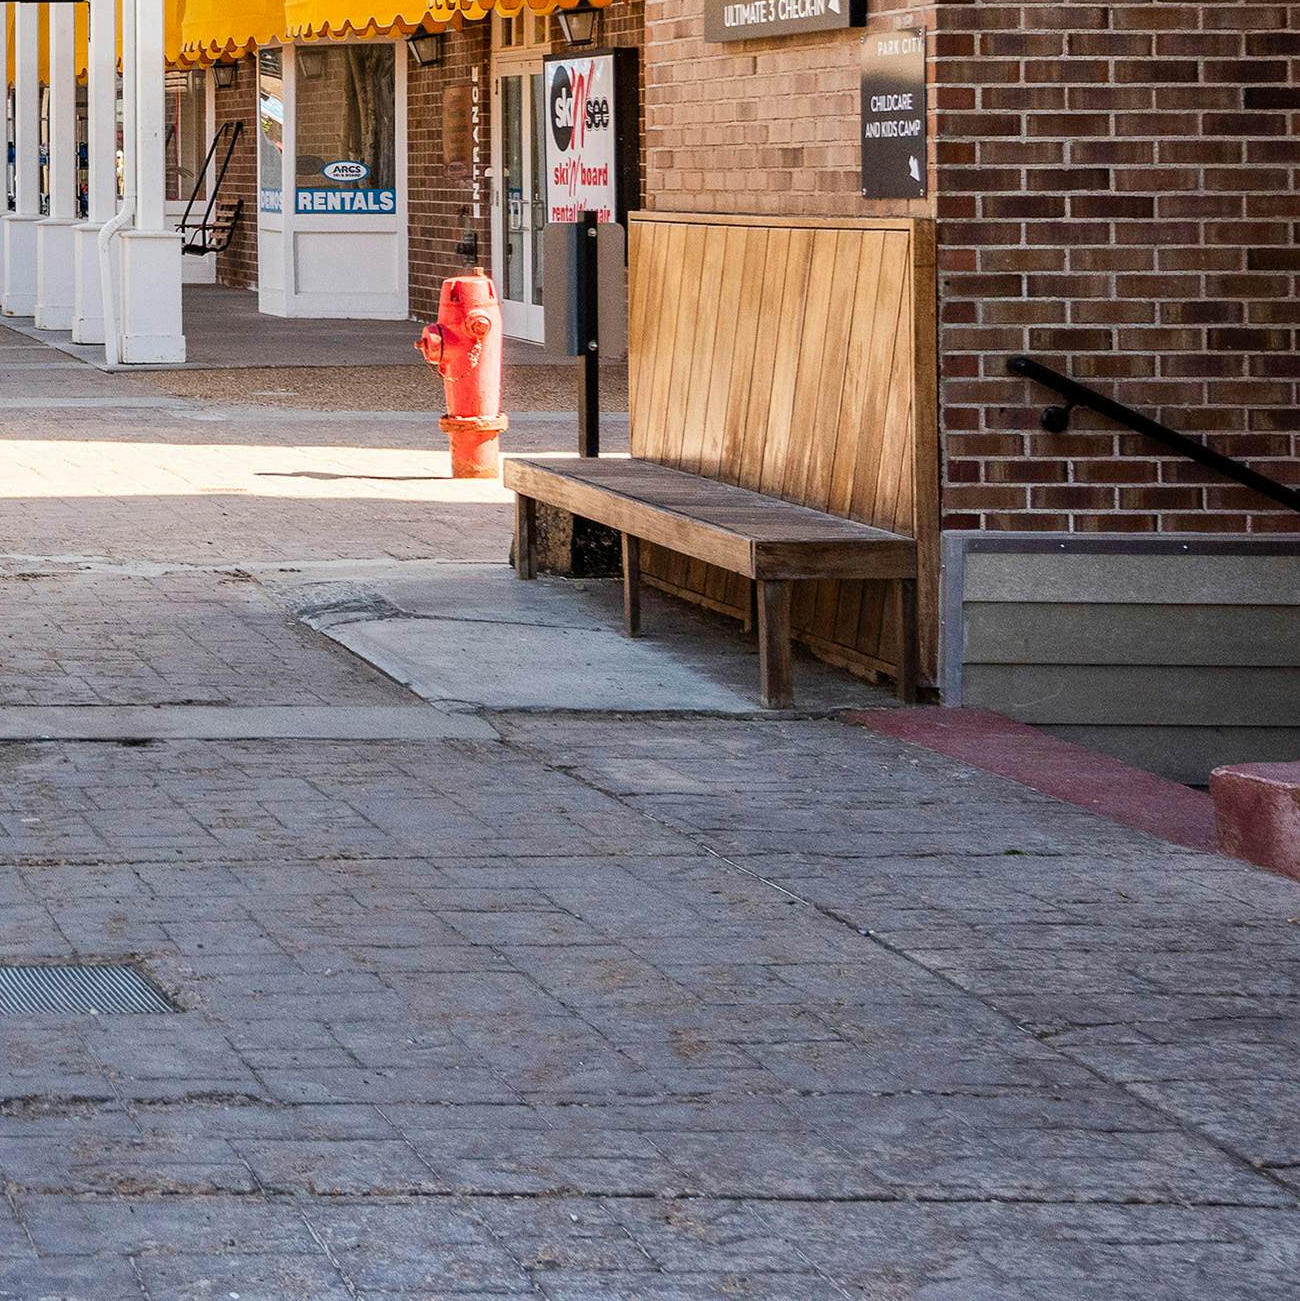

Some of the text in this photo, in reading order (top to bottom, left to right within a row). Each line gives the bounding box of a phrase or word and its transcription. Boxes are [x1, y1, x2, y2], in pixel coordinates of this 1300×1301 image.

[724, 1, 767, 27] ULTIMATE
[768, 0, 776, 22] 3
[877, 37, 923, 57] PARK CITY
[871, 93, 913, 113] CHILDCARE
[865, 119, 921, 138] AND KIDS CAMP
[472, 66, 480, 218] ENTRANCE
[333, 165, 361, 174] ARCS
[298, 191, 394, 211] RENTALS
